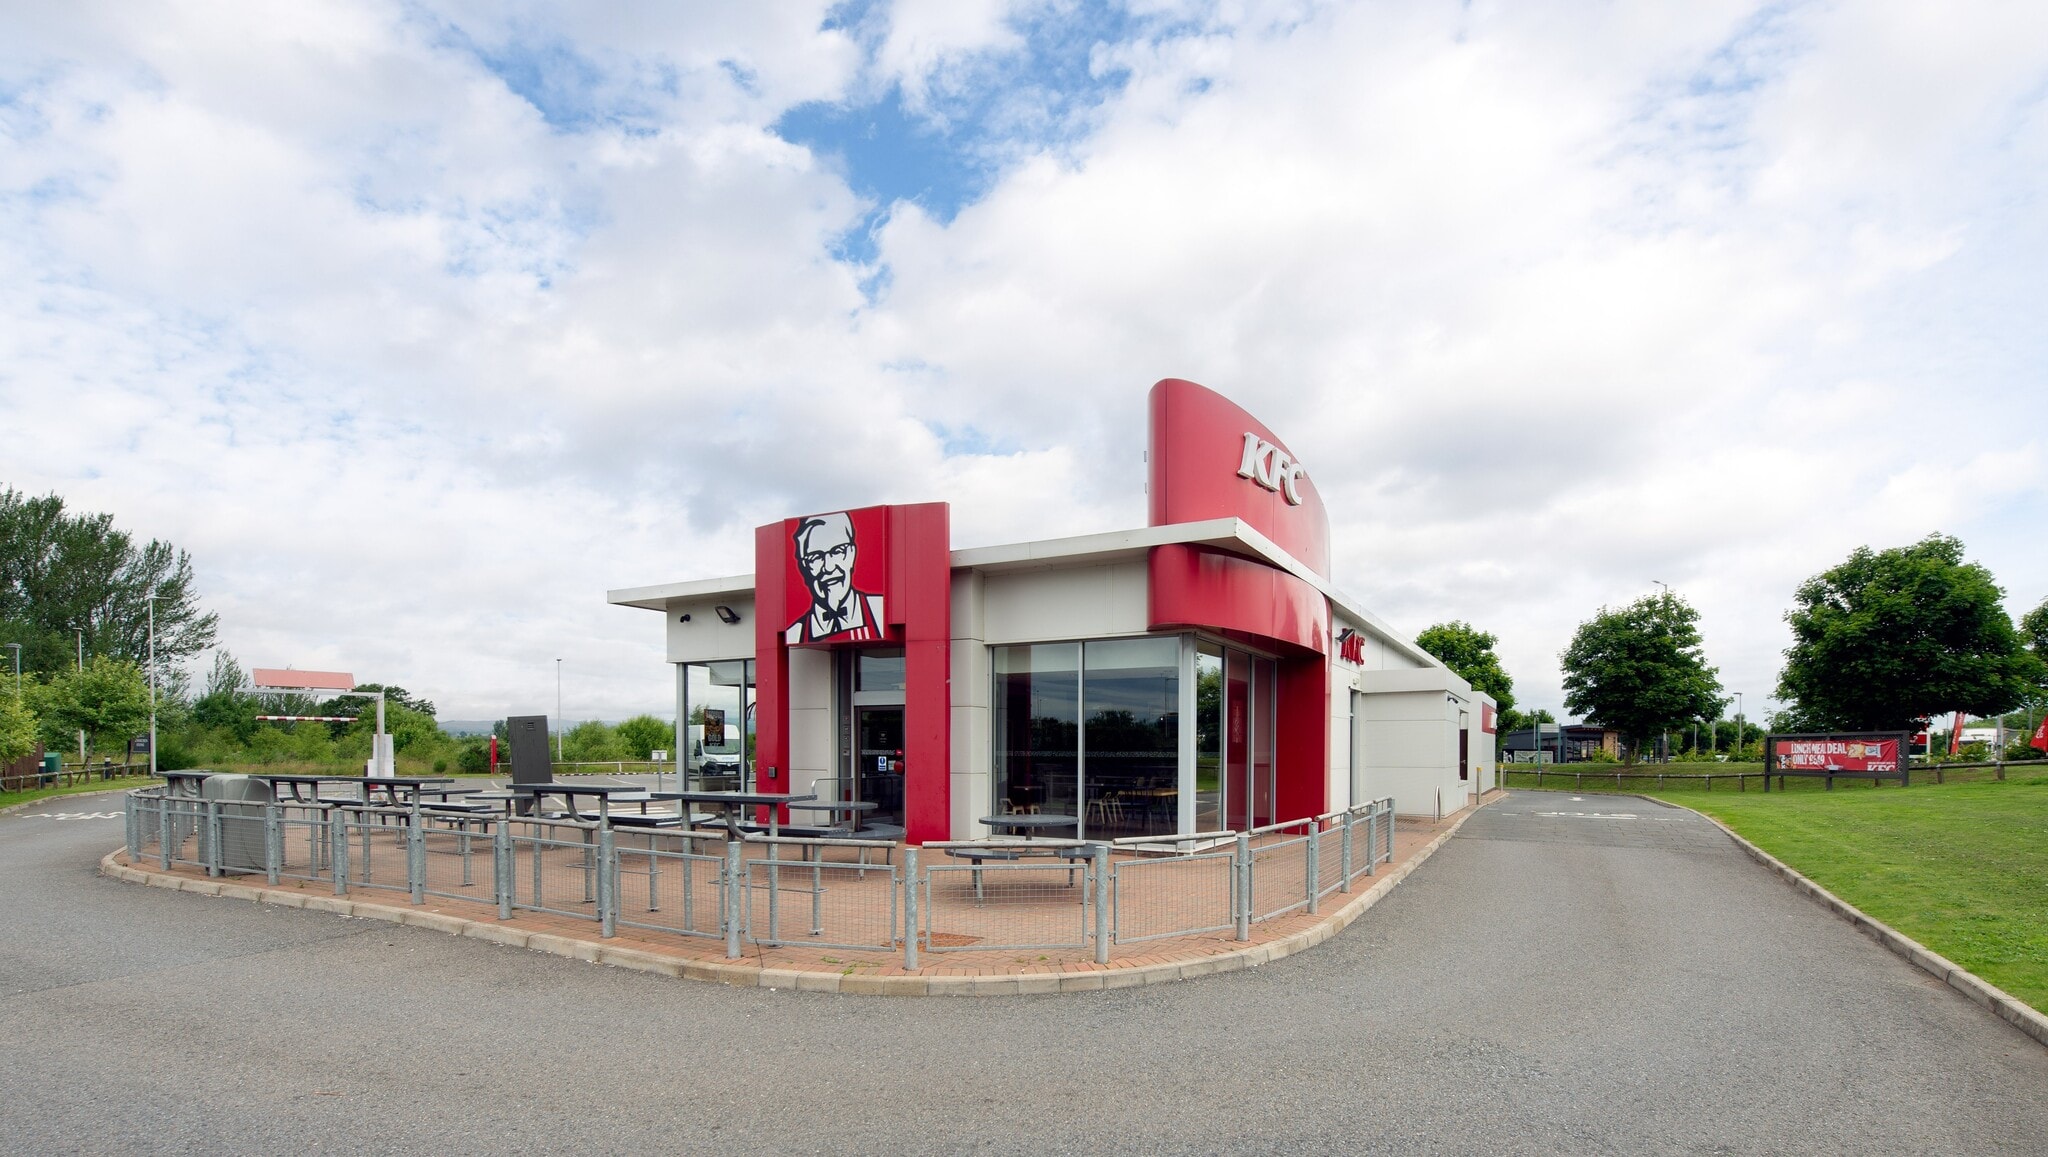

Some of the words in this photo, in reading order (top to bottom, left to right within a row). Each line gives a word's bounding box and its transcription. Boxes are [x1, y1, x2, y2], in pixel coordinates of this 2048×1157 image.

[1237, 432, 1304, 506] KFC
[1791, 743, 1811, 754] LUNCH
[1811, 743, 1826, 754] MEAL
[1827, 743, 1847, 754] DEAL
[1792, 754, 1808, 765] ONLY
